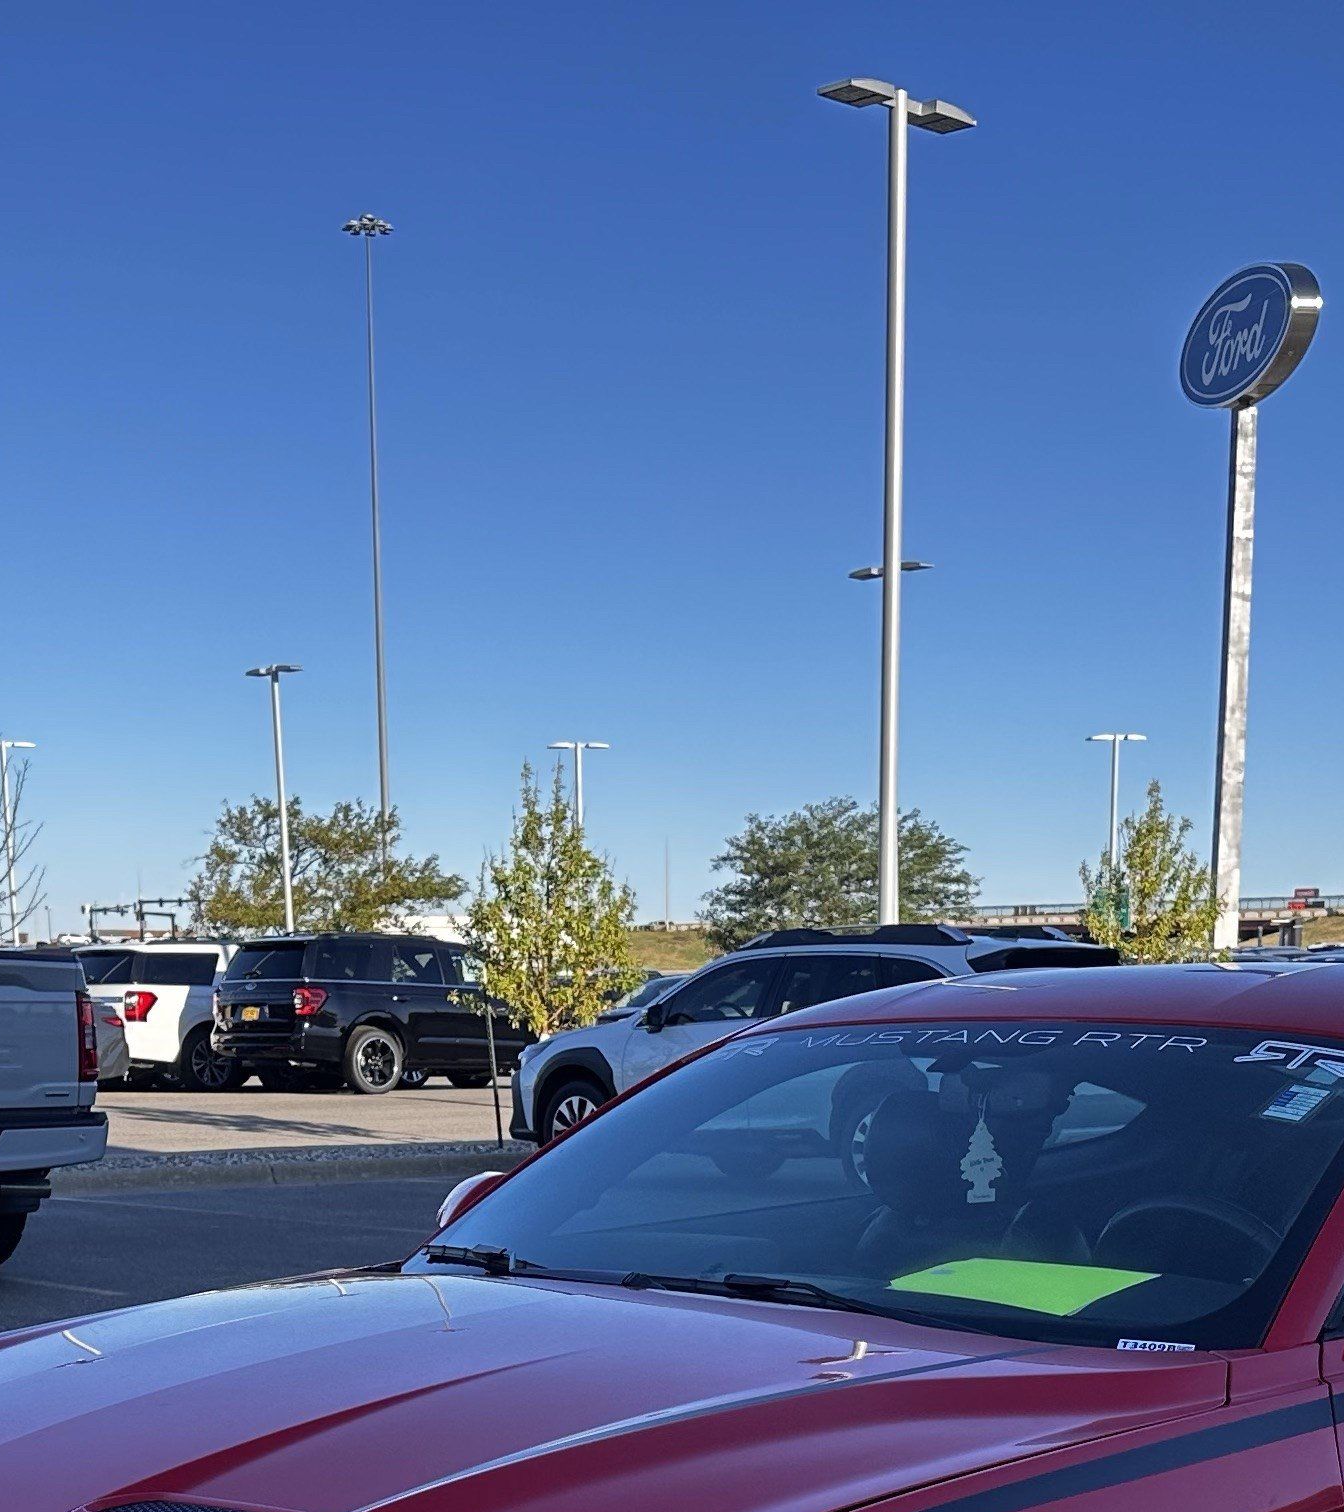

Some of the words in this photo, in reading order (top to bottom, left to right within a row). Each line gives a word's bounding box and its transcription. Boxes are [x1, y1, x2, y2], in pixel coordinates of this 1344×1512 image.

[1201, 292, 1269, 386] Ford
[800, 1028, 1064, 1049] MUSTANG
[1072, 1030, 1208, 1053] RTR
